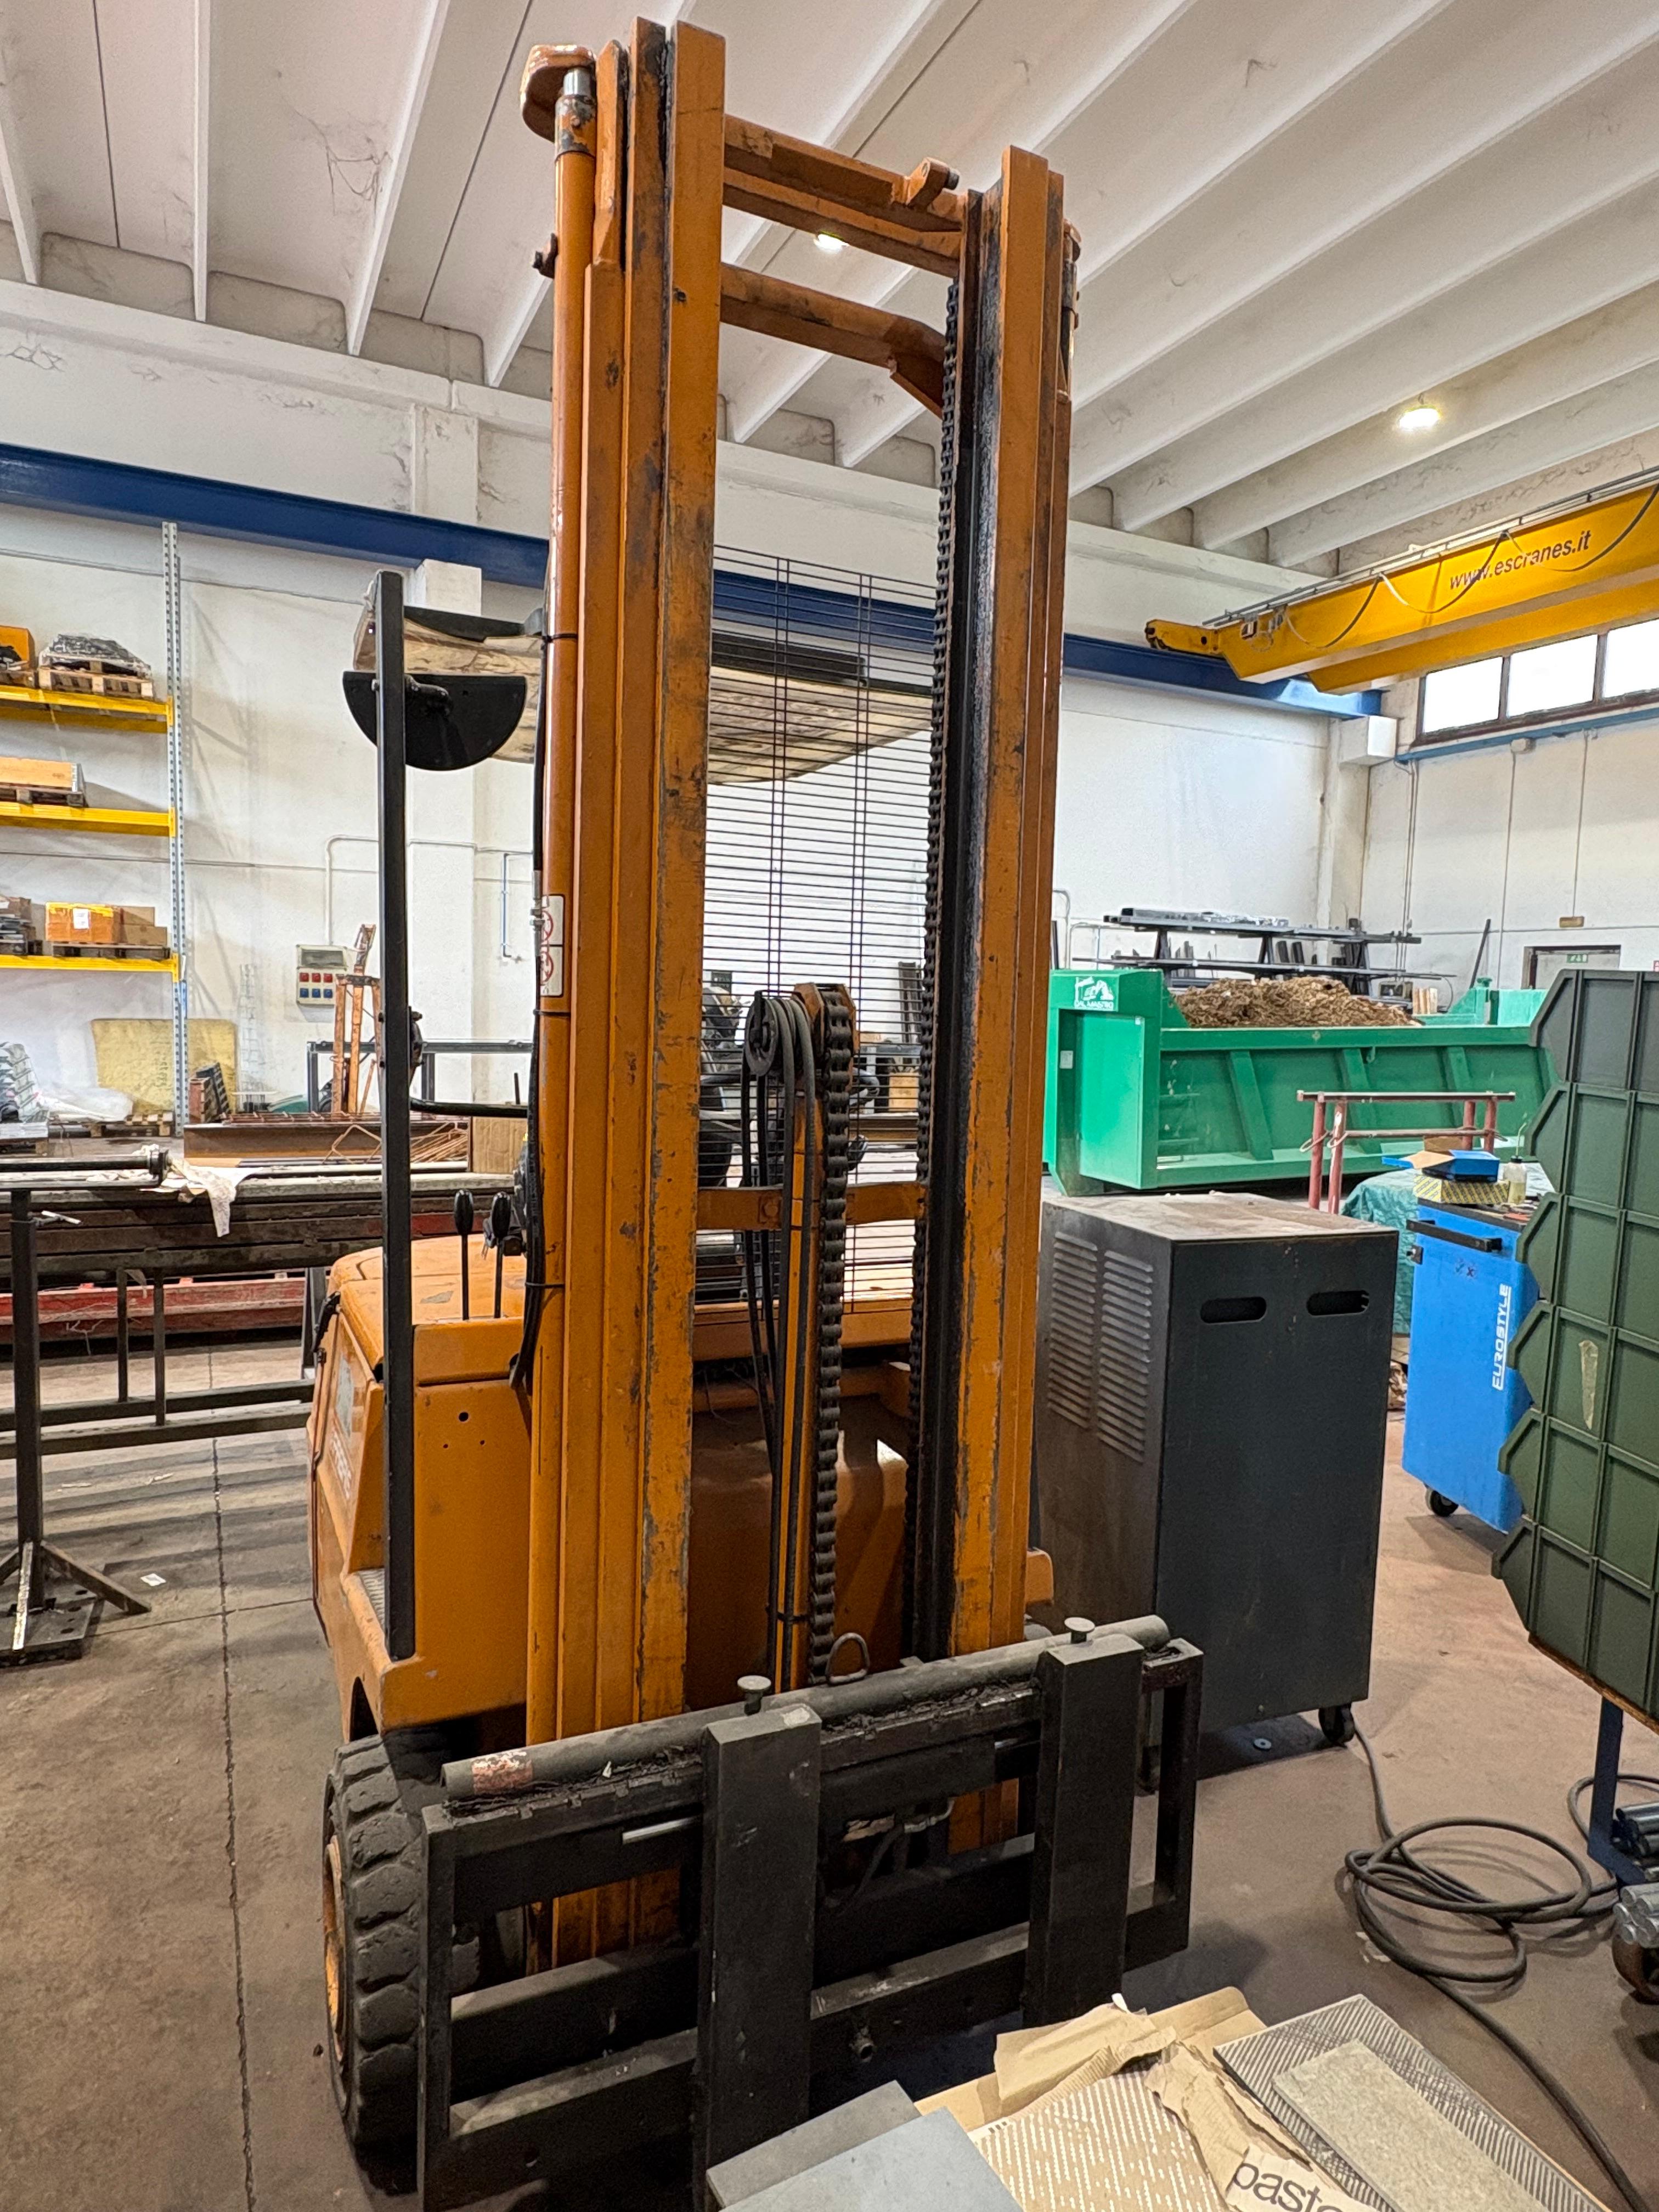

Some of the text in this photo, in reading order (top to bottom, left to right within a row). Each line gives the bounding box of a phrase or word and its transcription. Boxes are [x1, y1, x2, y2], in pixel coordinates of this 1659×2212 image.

[1449, 530, 1591, 590] www.escranes.it
[1492, 1283, 1511, 1391] EUROSTYLE
[1226, 2163, 1344, 2212] past
